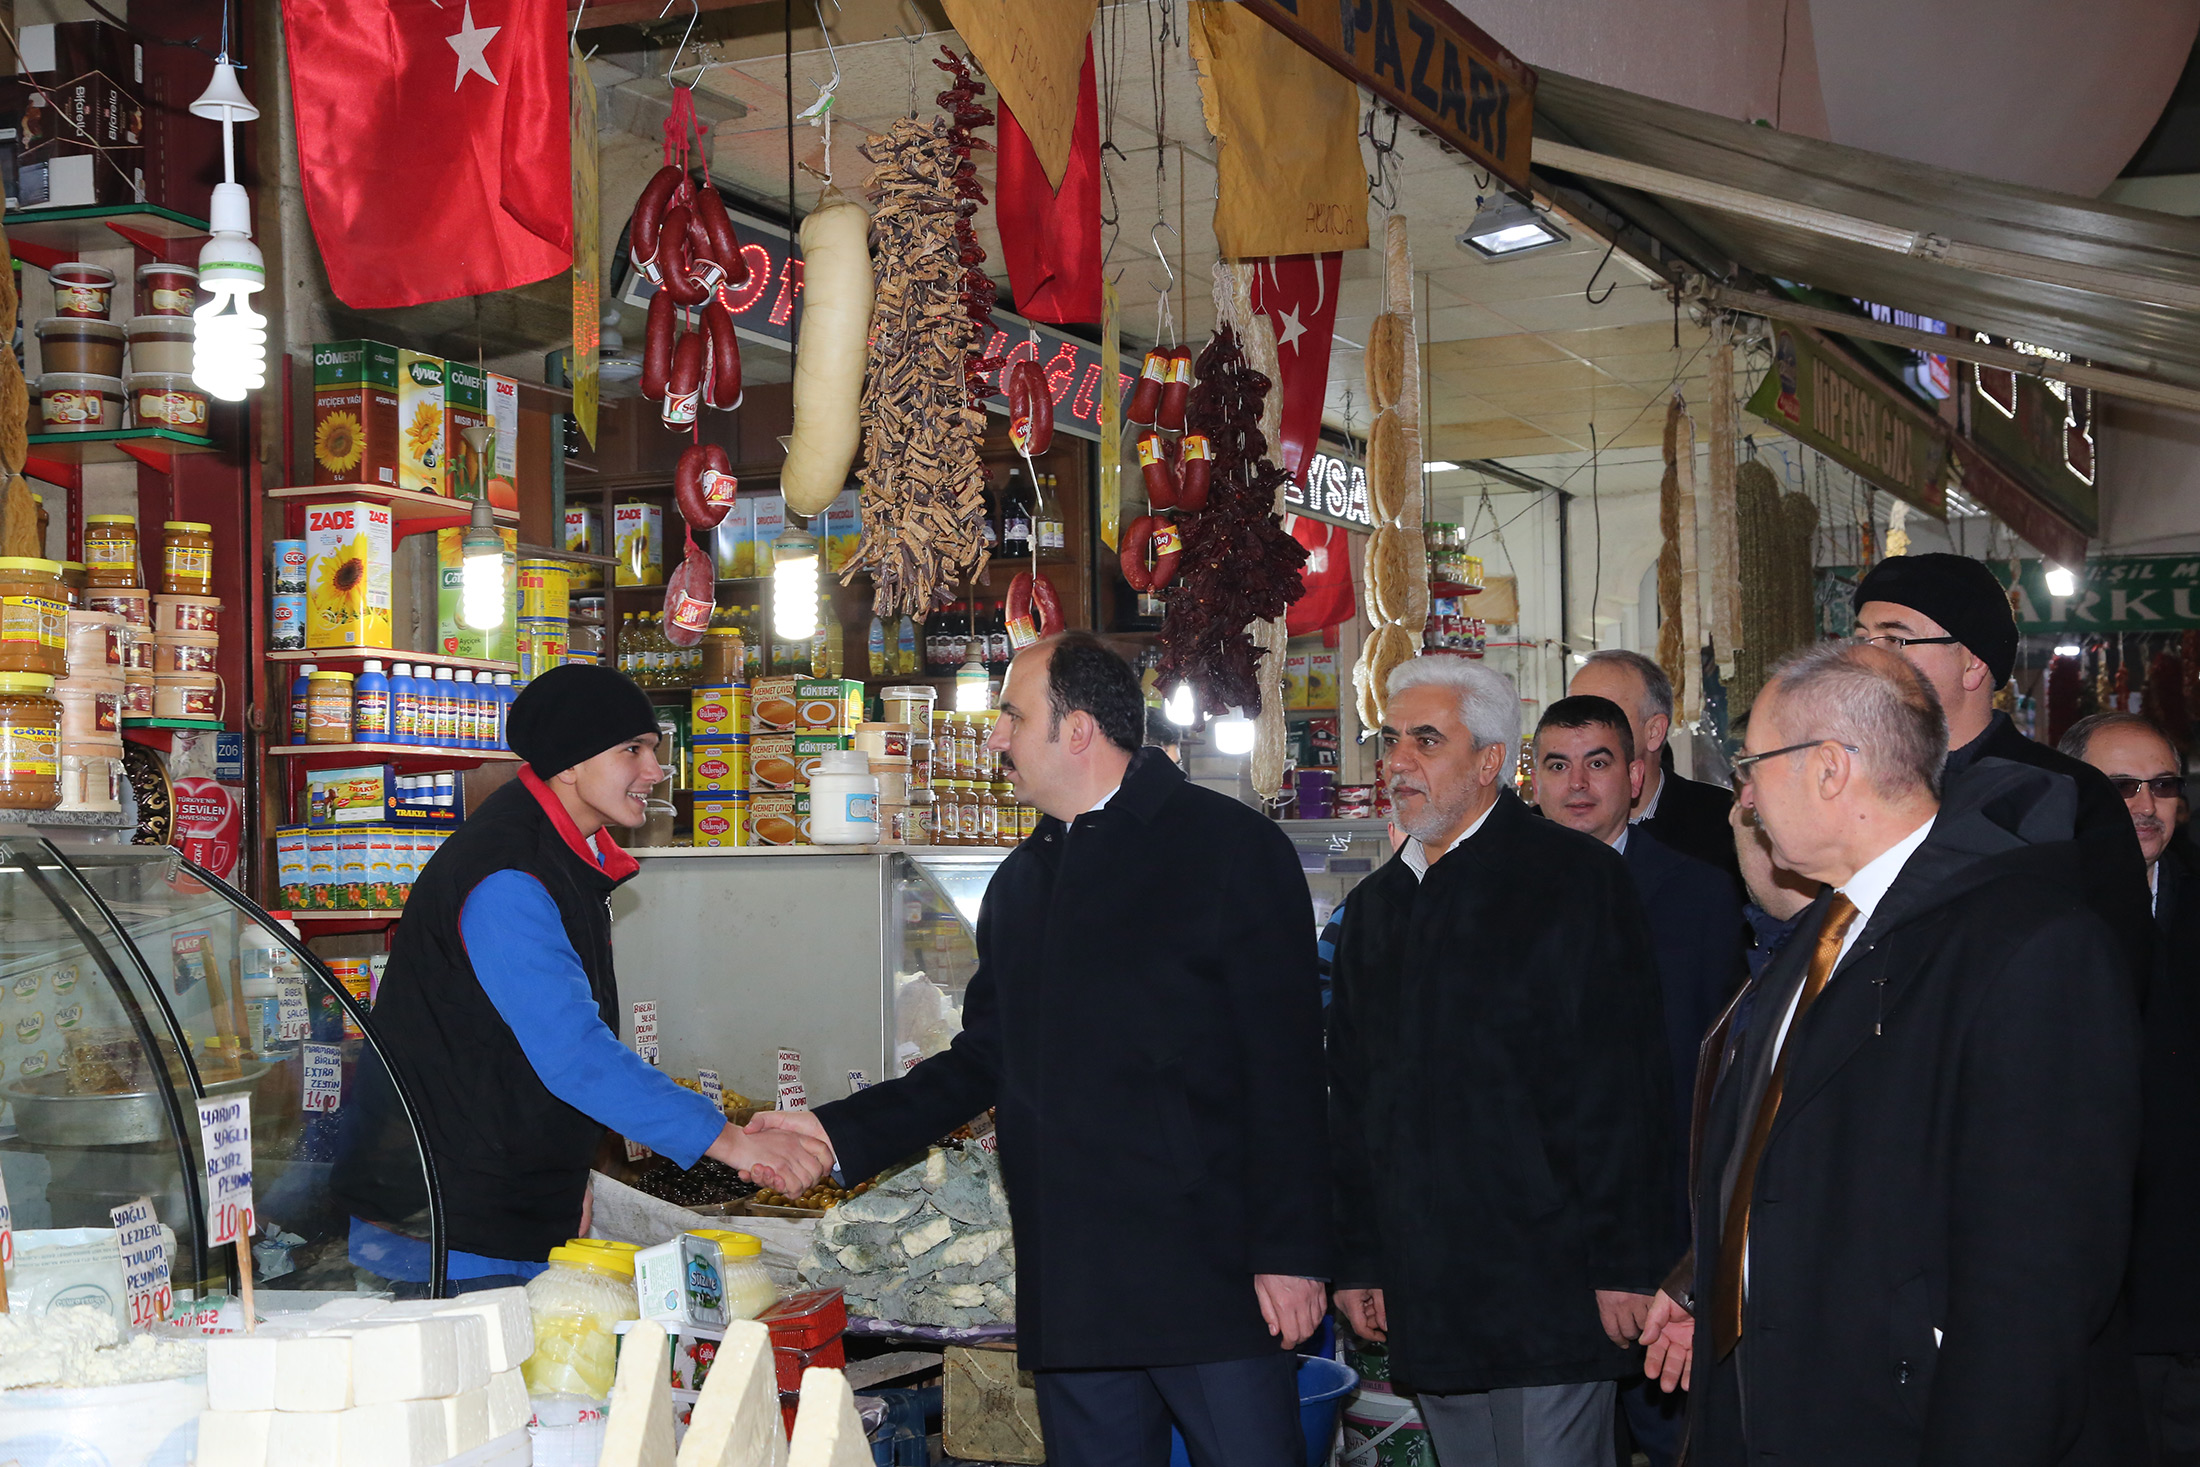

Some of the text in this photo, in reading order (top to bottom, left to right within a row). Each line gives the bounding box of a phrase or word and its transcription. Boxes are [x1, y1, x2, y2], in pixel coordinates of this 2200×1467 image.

[1341, 0, 1510, 161] PAZARI
[108, 90, 117, 140] Bifarella
[315, 350, 363, 365] CÖMERT
[412, 363, 442, 384] Ayvaz
[496, 382, 515, 396] ZADE
[310, 510, 355, 531] ZADE
[369, 510, 388, 524] ZADE
[565, 513, 583, 524] ADE
[616, 508, 641, 520] ZADE
[801, 684, 839, 696] GÖKTEPE
[218, 745, 239, 757] Z06
[799, 741, 837, 752] GÖKTEPE
[177, 814, 219, 822] AHVESİNDEN
[395, 808, 427, 818] TRAKYA
[304, 1066, 334, 1077] EXTRA
[201, 1103, 241, 1128] YARIM
[213, 1126, 249, 1150] YAĞLI
[207, 1152, 244, 1178] BEYAZ
[114, 1205, 147, 1228] YAĞLI
[123, 1245, 164, 1268] TULUM
